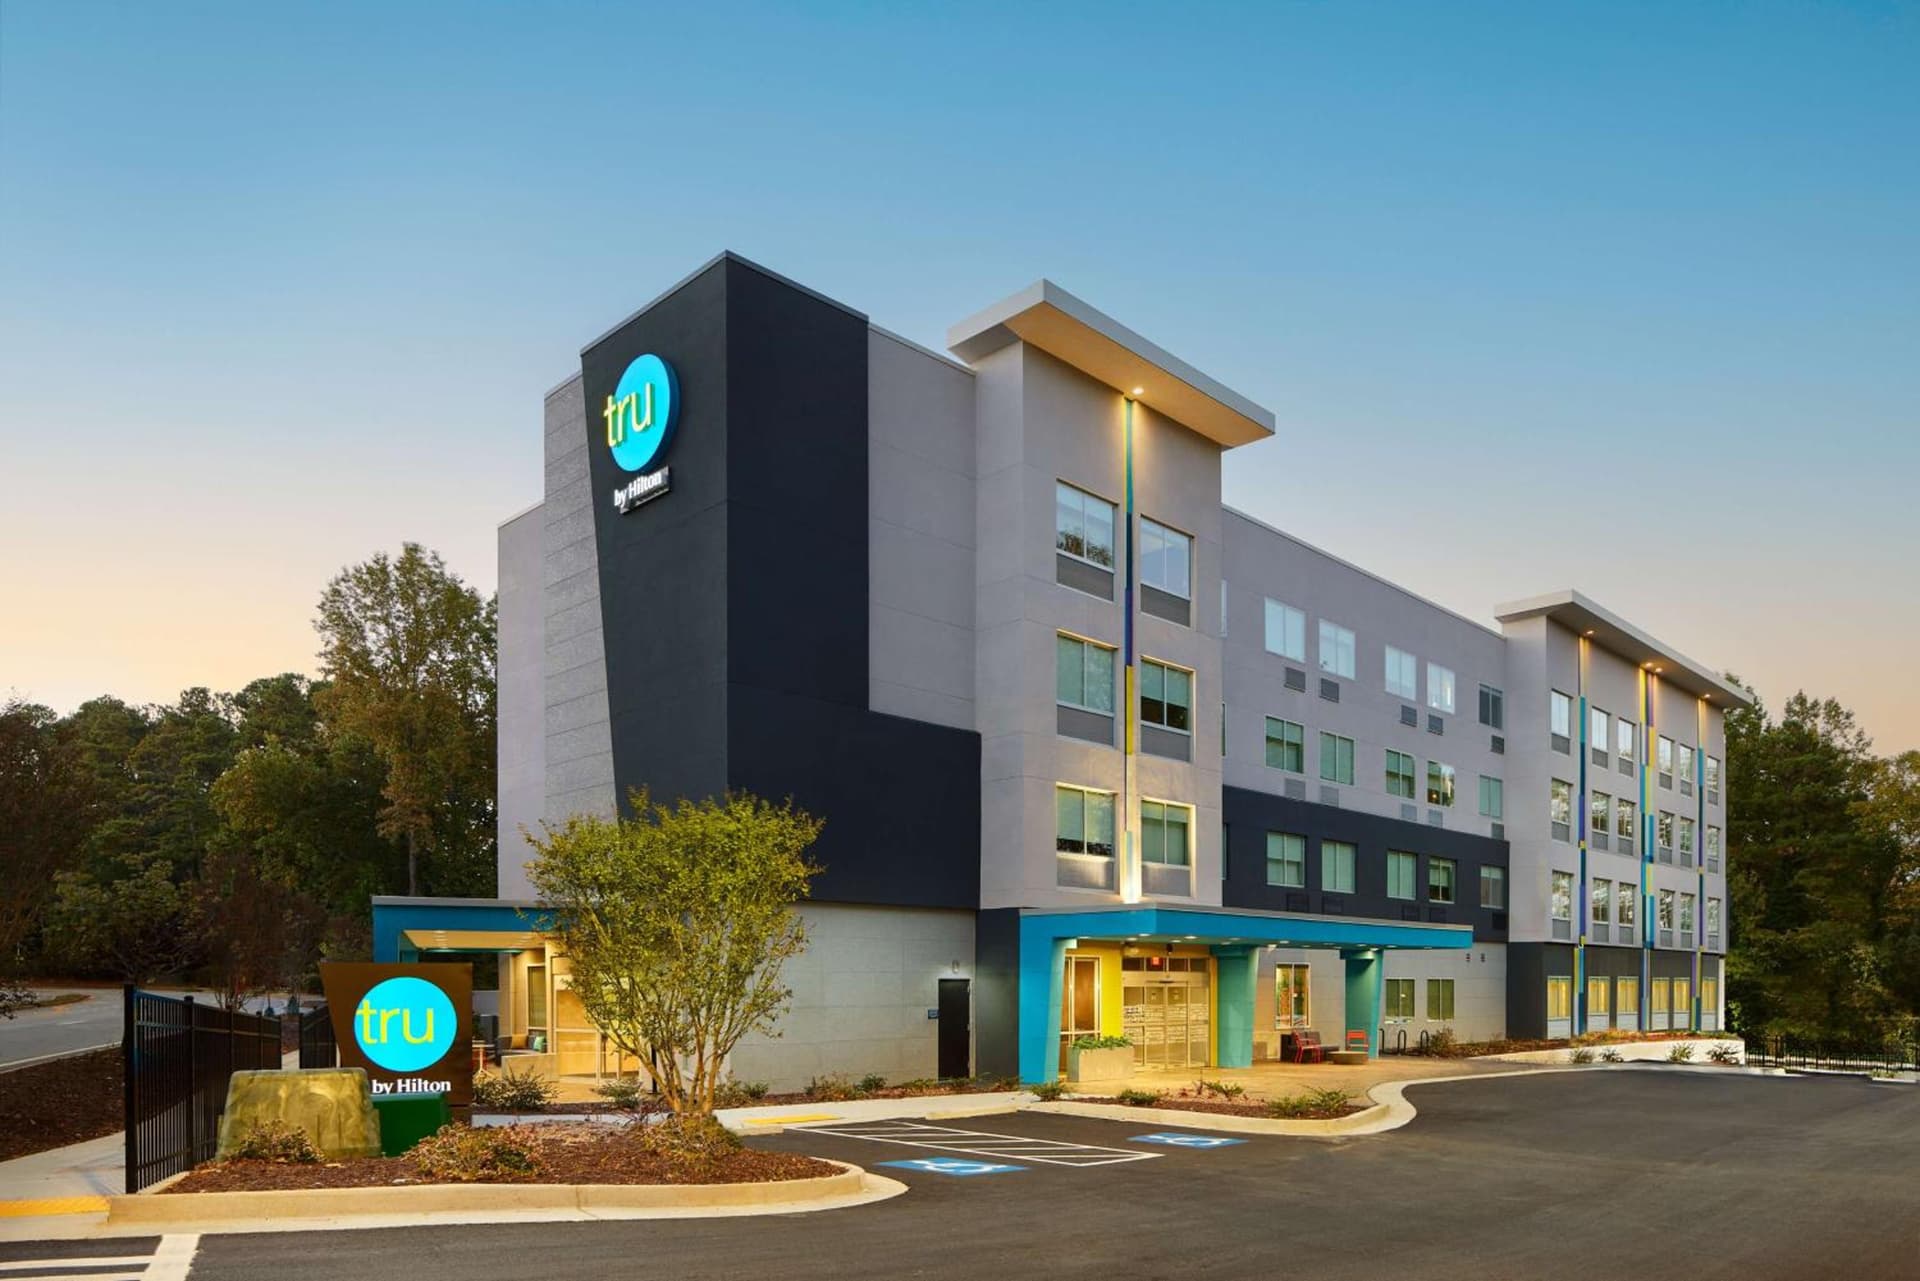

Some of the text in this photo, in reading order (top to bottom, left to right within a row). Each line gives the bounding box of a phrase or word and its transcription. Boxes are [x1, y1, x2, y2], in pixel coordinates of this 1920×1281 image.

[603, 382, 653, 447] tru
[614, 471, 662, 508] by Hilton
[356, 1000, 434, 1044] tru
[372, 1078, 451, 1094] by Hilton
